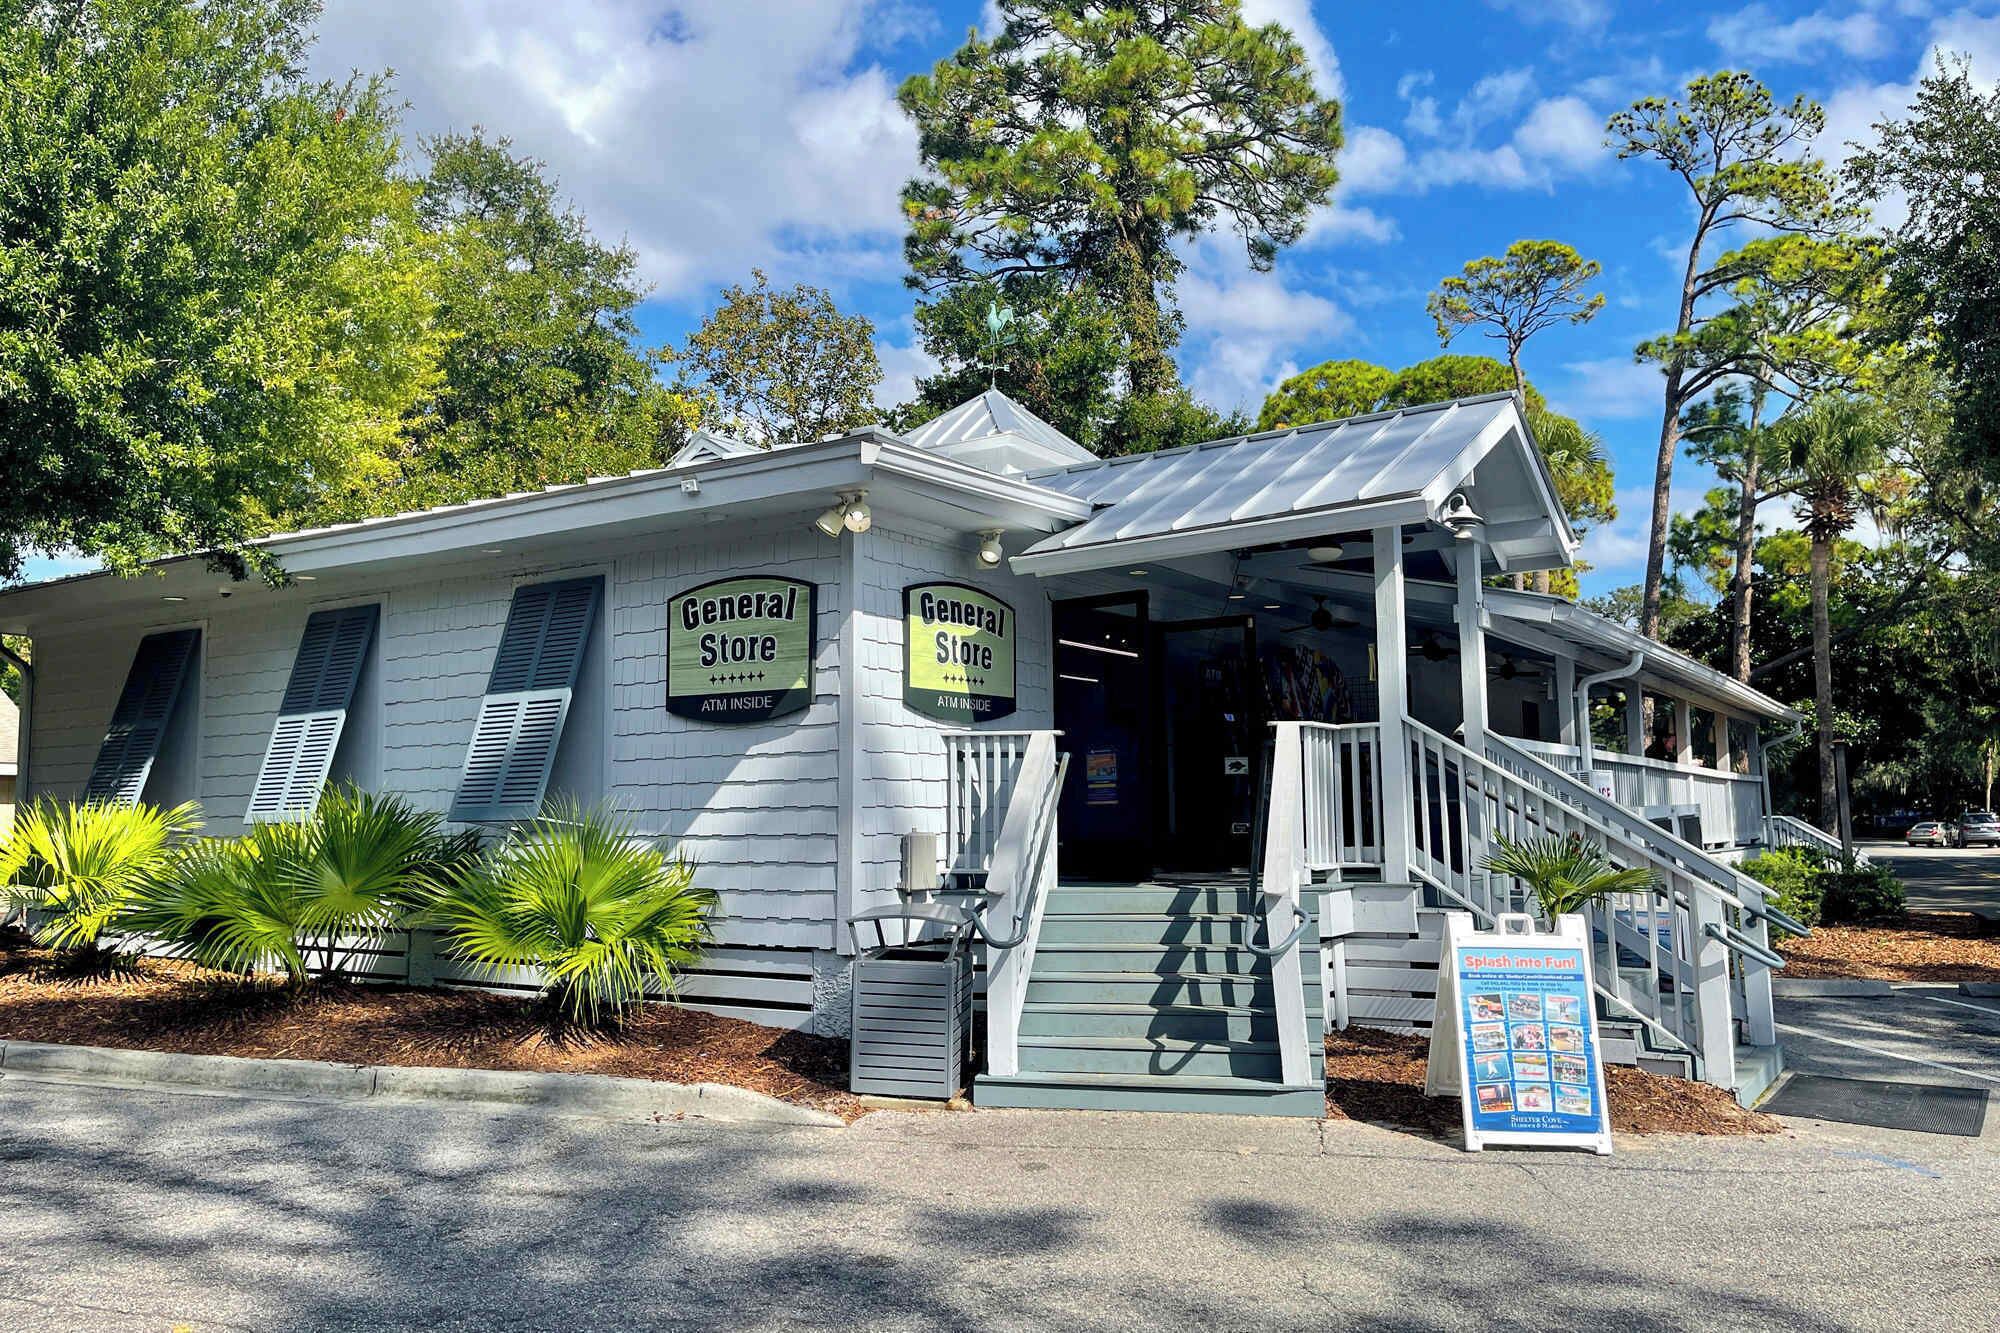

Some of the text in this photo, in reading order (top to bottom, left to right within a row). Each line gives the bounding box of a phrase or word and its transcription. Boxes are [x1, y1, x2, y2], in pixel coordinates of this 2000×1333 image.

[681, 586, 797, 632] General
[920, 592, 1005, 637] General
[700, 633, 776, 668] Store
[935, 631, 992, 670] Store
[702, 696, 773, 713] ATM INSIDE
[937, 694, 992, 713] ATM INSIDE
[1464, 954, 1577, 971] Splash into Fun!
